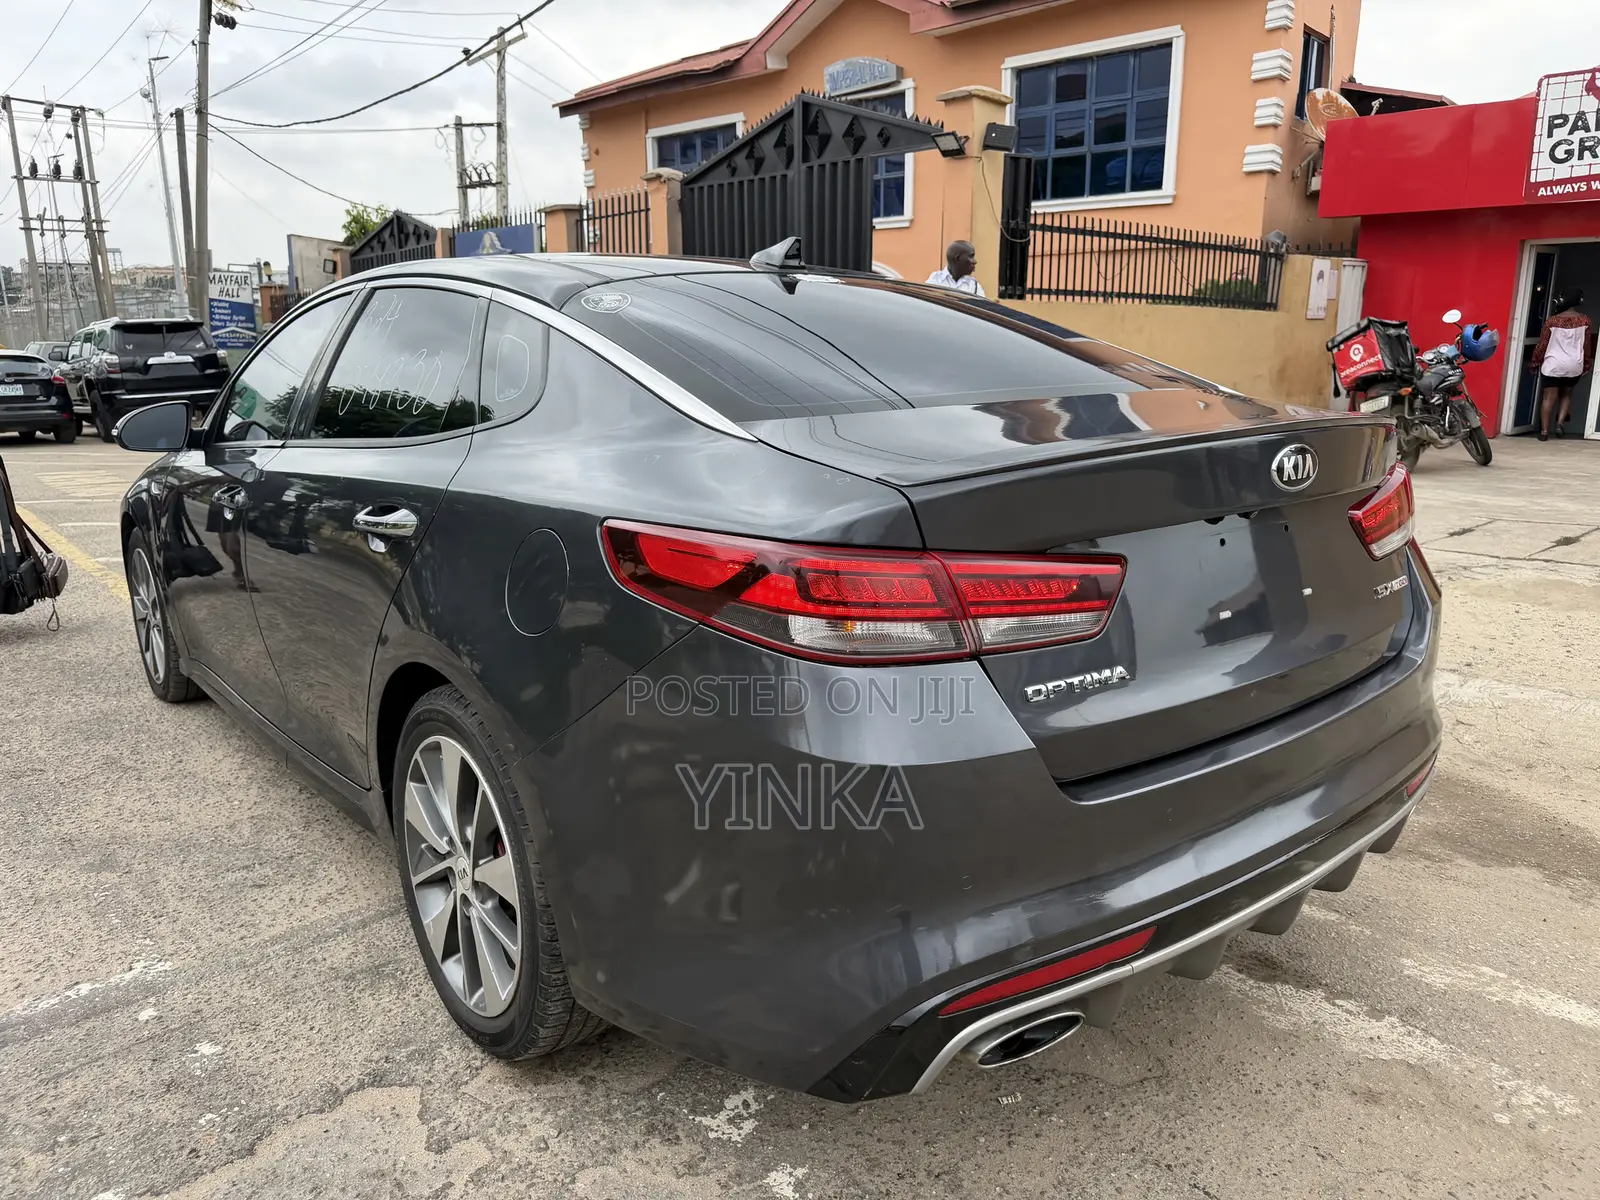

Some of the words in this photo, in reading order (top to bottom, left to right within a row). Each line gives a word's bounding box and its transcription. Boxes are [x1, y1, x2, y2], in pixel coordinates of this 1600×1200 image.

[1548, 136, 1600, 164] GR
[1537, 182, 1587, 196] ALWAYS
[208, 273, 249, 287] MAYFAIR
[218, 286, 241, 298] HALL
[1281, 453, 1314, 482] KIA
[1024, 665, 1131, 702] OPTIMA
